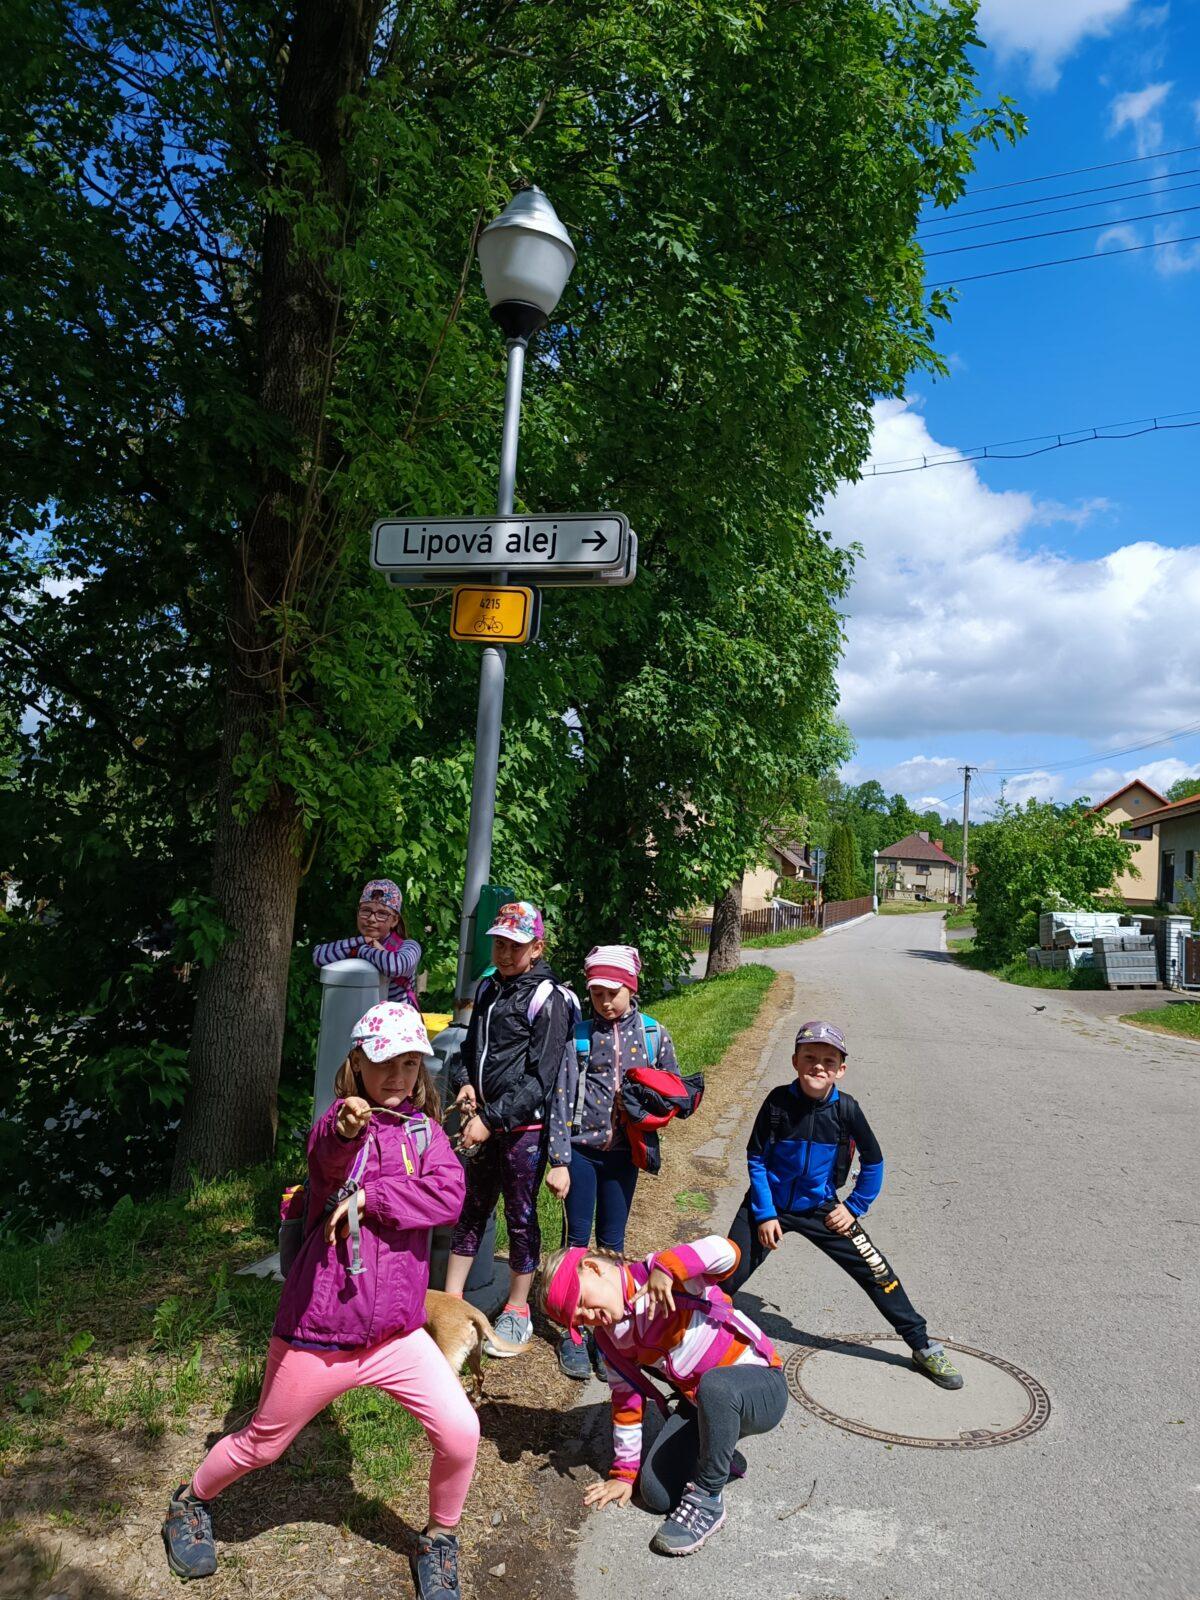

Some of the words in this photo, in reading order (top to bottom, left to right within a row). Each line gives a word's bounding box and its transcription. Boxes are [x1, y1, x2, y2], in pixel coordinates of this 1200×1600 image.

[402, 526, 493, 561] Lipová
[505, 525, 558, 560] alej
[480, 598, 501, 609] 4215
